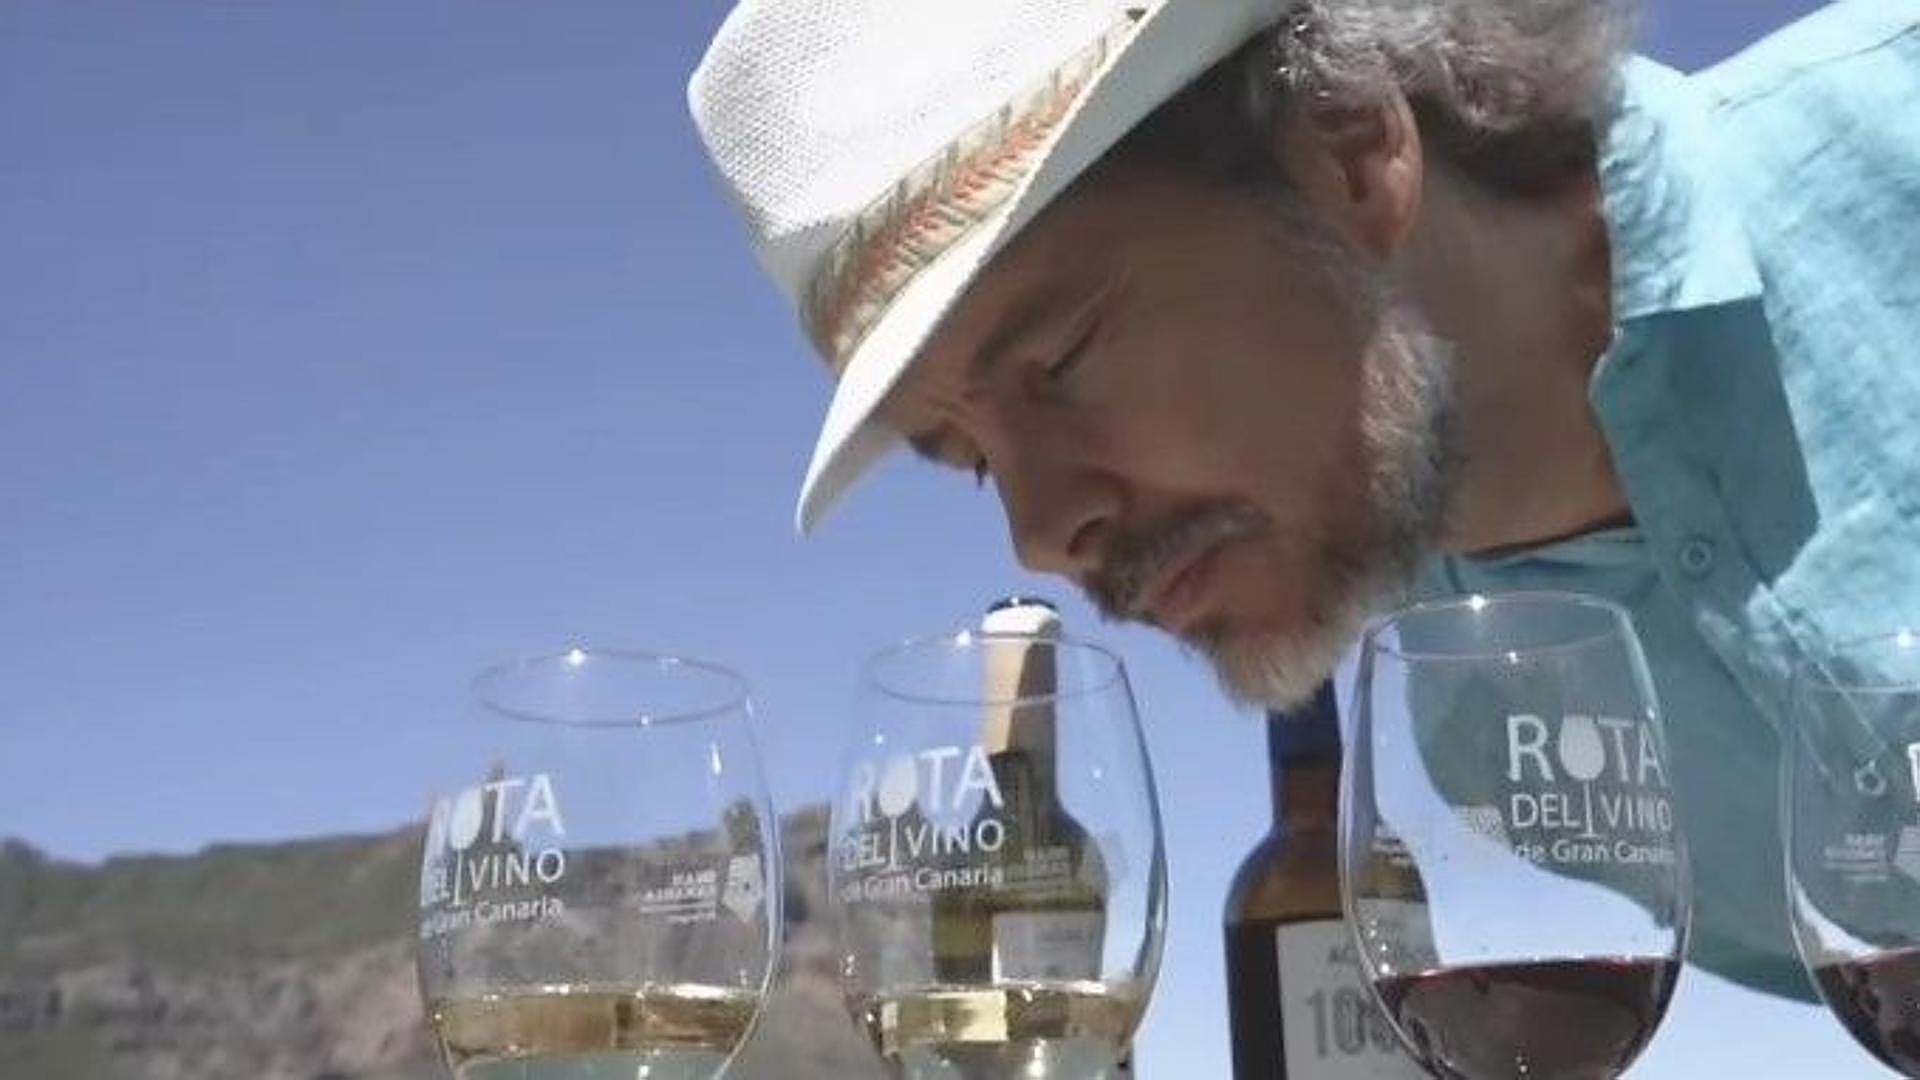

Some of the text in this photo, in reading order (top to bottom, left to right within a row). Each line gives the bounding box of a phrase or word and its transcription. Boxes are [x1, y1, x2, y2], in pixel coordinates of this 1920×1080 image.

[1507, 713, 1667, 786] ROTA
[1511, 792, 1581, 828] DEL
[1601, 794, 1673, 833] VINO
[904, 818, 1005, 857] VINO
[1552, 838, 1611, 863] Gran
[467, 848, 566, 892] VINO
[915, 862, 1005, 891] Canaria
